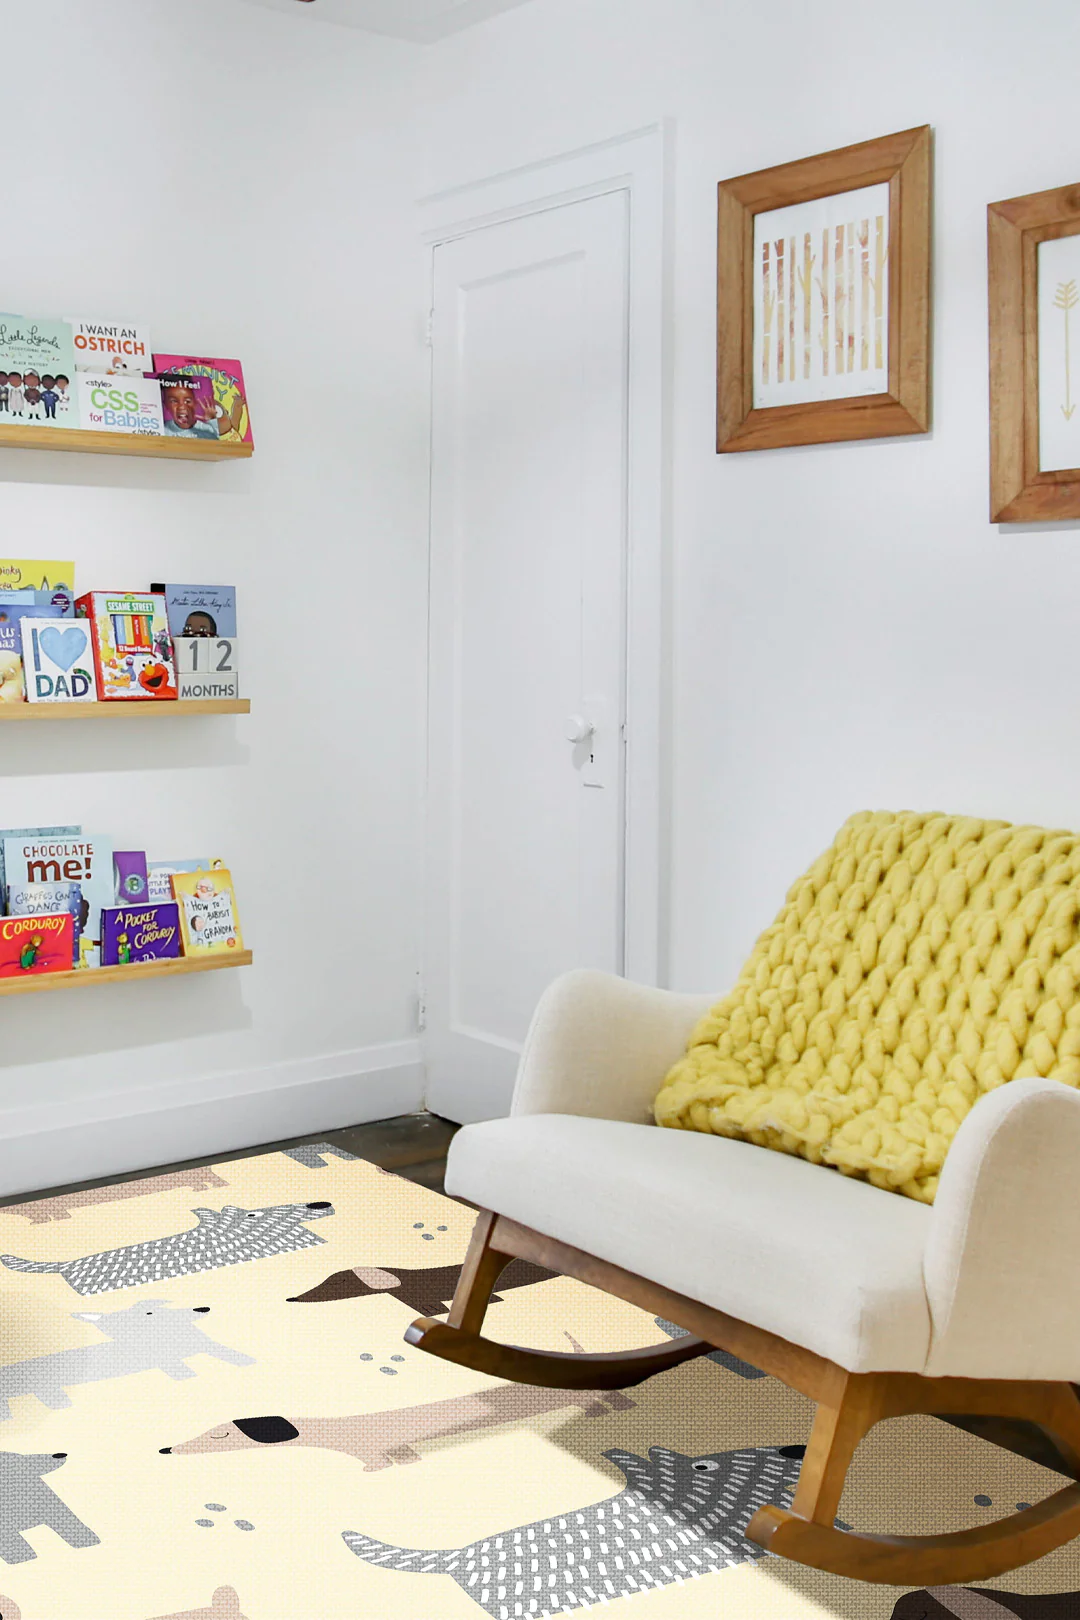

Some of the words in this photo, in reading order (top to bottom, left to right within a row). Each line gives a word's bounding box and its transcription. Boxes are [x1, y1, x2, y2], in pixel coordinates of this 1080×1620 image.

[80, 323, 84, 333] I
[85, 324, 118, 337] WANT
[120, 328, 137, 339] AN
[74, 335, 145, 356] OSTRICH
[159, 379, 177, 388] How
[184, 380, 201, 390] Feel
[90, 388, 140, 413] CSS
[89, 412, 103, 423] for
[104, 409, 160, 430] Babies
[107, 601, 131, 611] SESAME
[131, 602, 153, 612] STREET
[31, 628, 41, 672] I
[35, 674, 89, 697] DAD
[181, 684, 235, 697] MONTHS
[23, 843, 94, 858] CHOCOLATE
[27, 857, 92, 883] me!
[27, 902, 61, 914] DANCE
[2, 917, 66, 940] CORDUROY
[114, 911, 123, 925] A
[124, 909, 158, 929] POCKET
[142, 921, 159, 933] FOR
[134, 926, 176, 952] CORDUROY
[203, 925, 232, 940] GRANDPA
